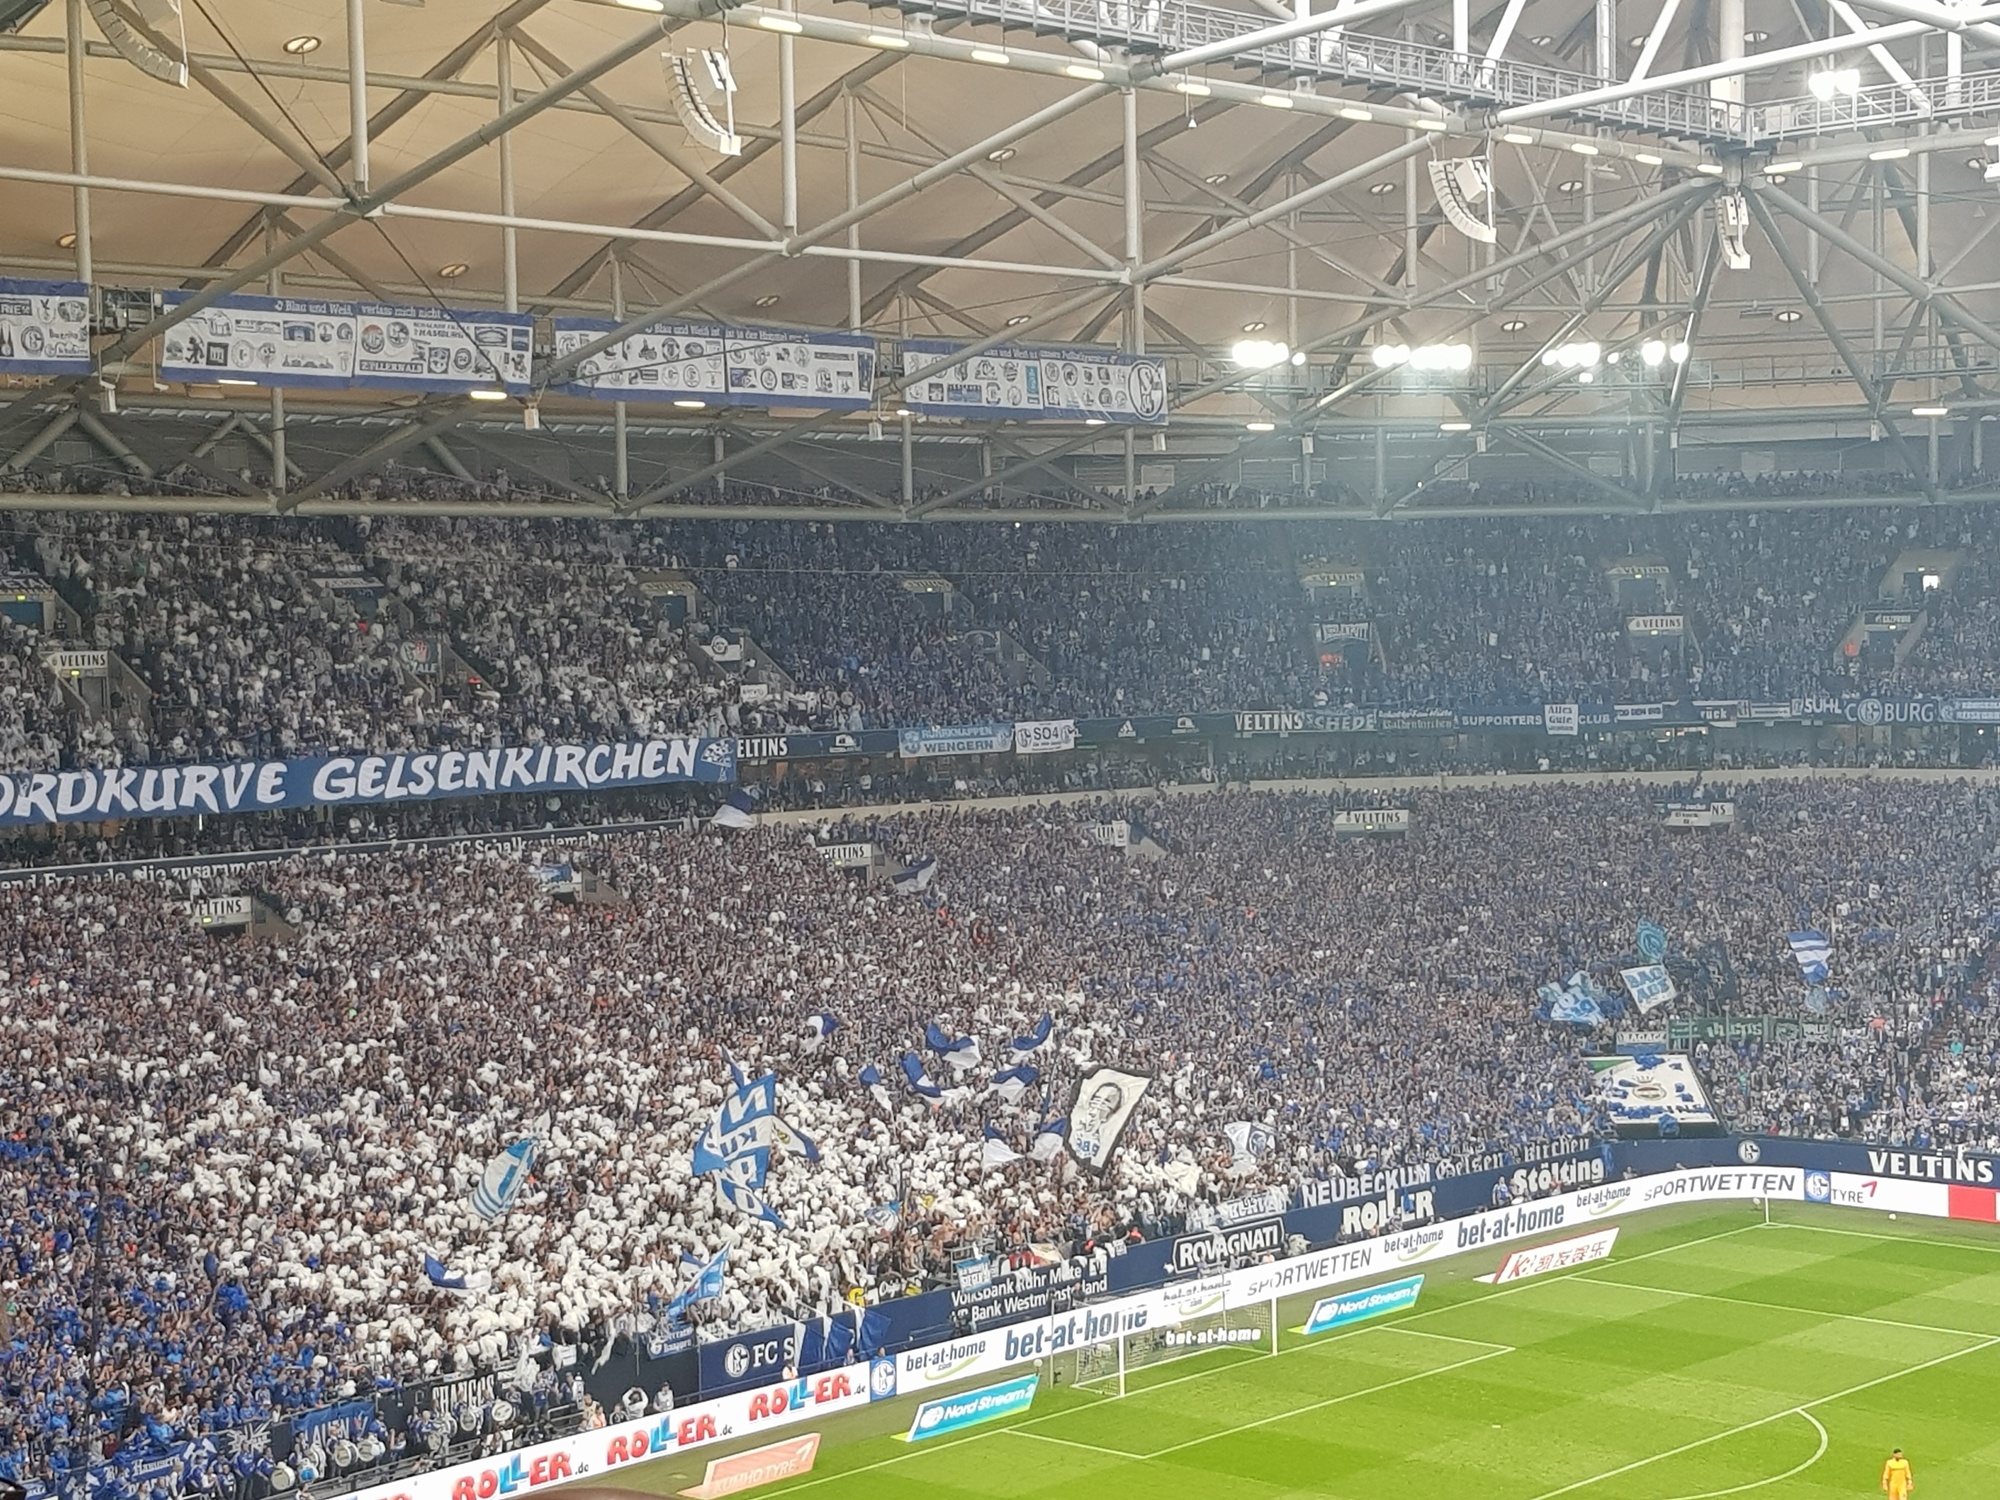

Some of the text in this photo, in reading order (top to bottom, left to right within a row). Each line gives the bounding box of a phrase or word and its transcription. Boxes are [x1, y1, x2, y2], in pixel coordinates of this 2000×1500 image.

[60, 654, 106, 667] VELTINS
[1235, 712, 1303, 731] VELTINS
[1462, 714, 1543, 726] SUPPORTERS
[737, 737, 787, 758] ELTINS
[924, 740, 994, 753] WENGERN
[312, 739, 699, 801] GELSENKIRCHEN
[1354, 812, 1401, 823] VELTINS
[1512, 1157, 1604, 1195] Stölting
[1867, 1149, 1994, 1183] VELTINS
[1576, 1185, 1632, 1208] bet-at-home
[1644, 1174, 1795, 1201] SPORTWETTEN
[1832, 1188, 1864, 1203] TYRE
[1458, 1204, 1564, 1248] bet-at-home
[1179, 1225, 1279, 1268] ROVAGNATI
[1384, 1228, 1444, 1254] bet-at-home
[972, 1302, 1002, 1322] Bank
[1337, 1296, 1369, 1316] Nord
[1368, 1288, 1408, 1310] Stream
[752, 1341, 777, 1368] FC
[906, 1340, 986, 1372] bet-at-home
[749, 1373, 852, 1422] ROLLER
[946, 1399, 977, 1420] Nord
[977, 1390, 1021, 1411] Stream
[606, 1413, 718, 1466] ROLLER
